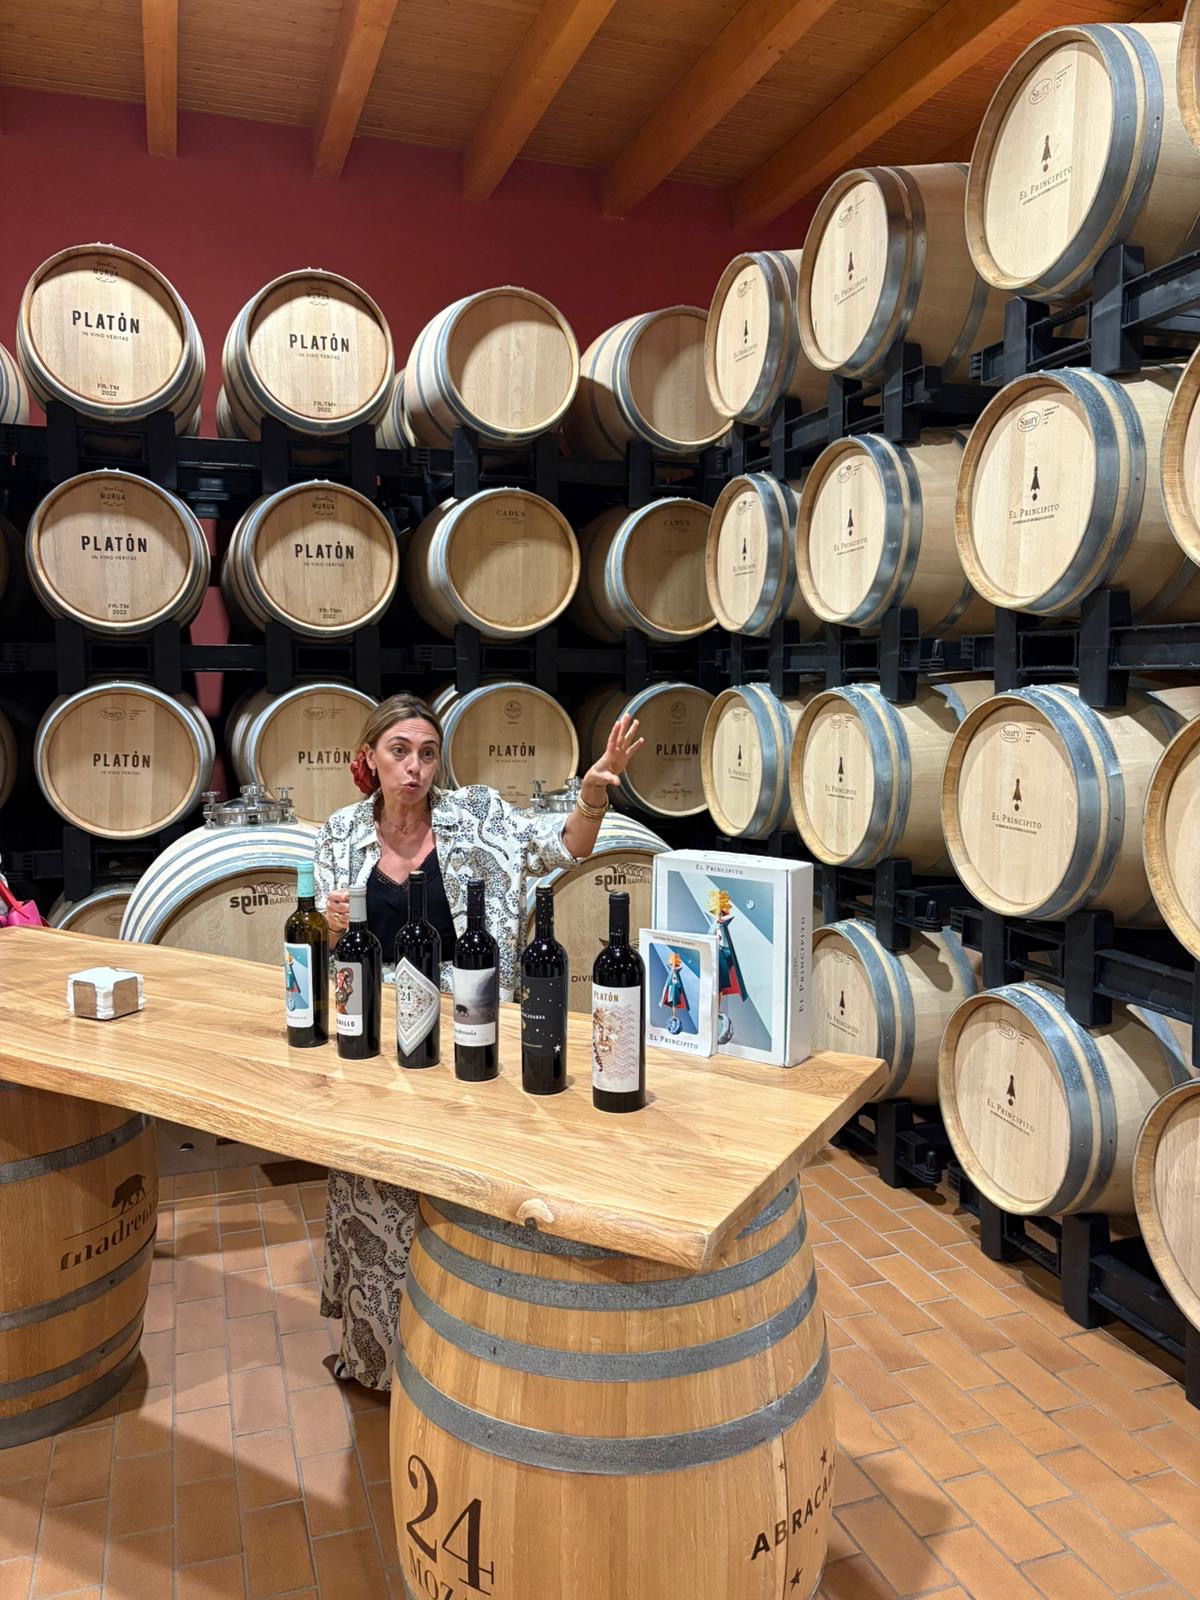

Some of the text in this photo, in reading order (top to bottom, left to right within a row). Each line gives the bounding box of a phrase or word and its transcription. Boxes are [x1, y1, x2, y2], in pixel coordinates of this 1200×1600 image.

[230, 885, 269, 915] spin
[594, 866, 627, 892] spin
[406, 1454, 494, 1596] 24
[408, 1544, 468, 1600] MOZ
